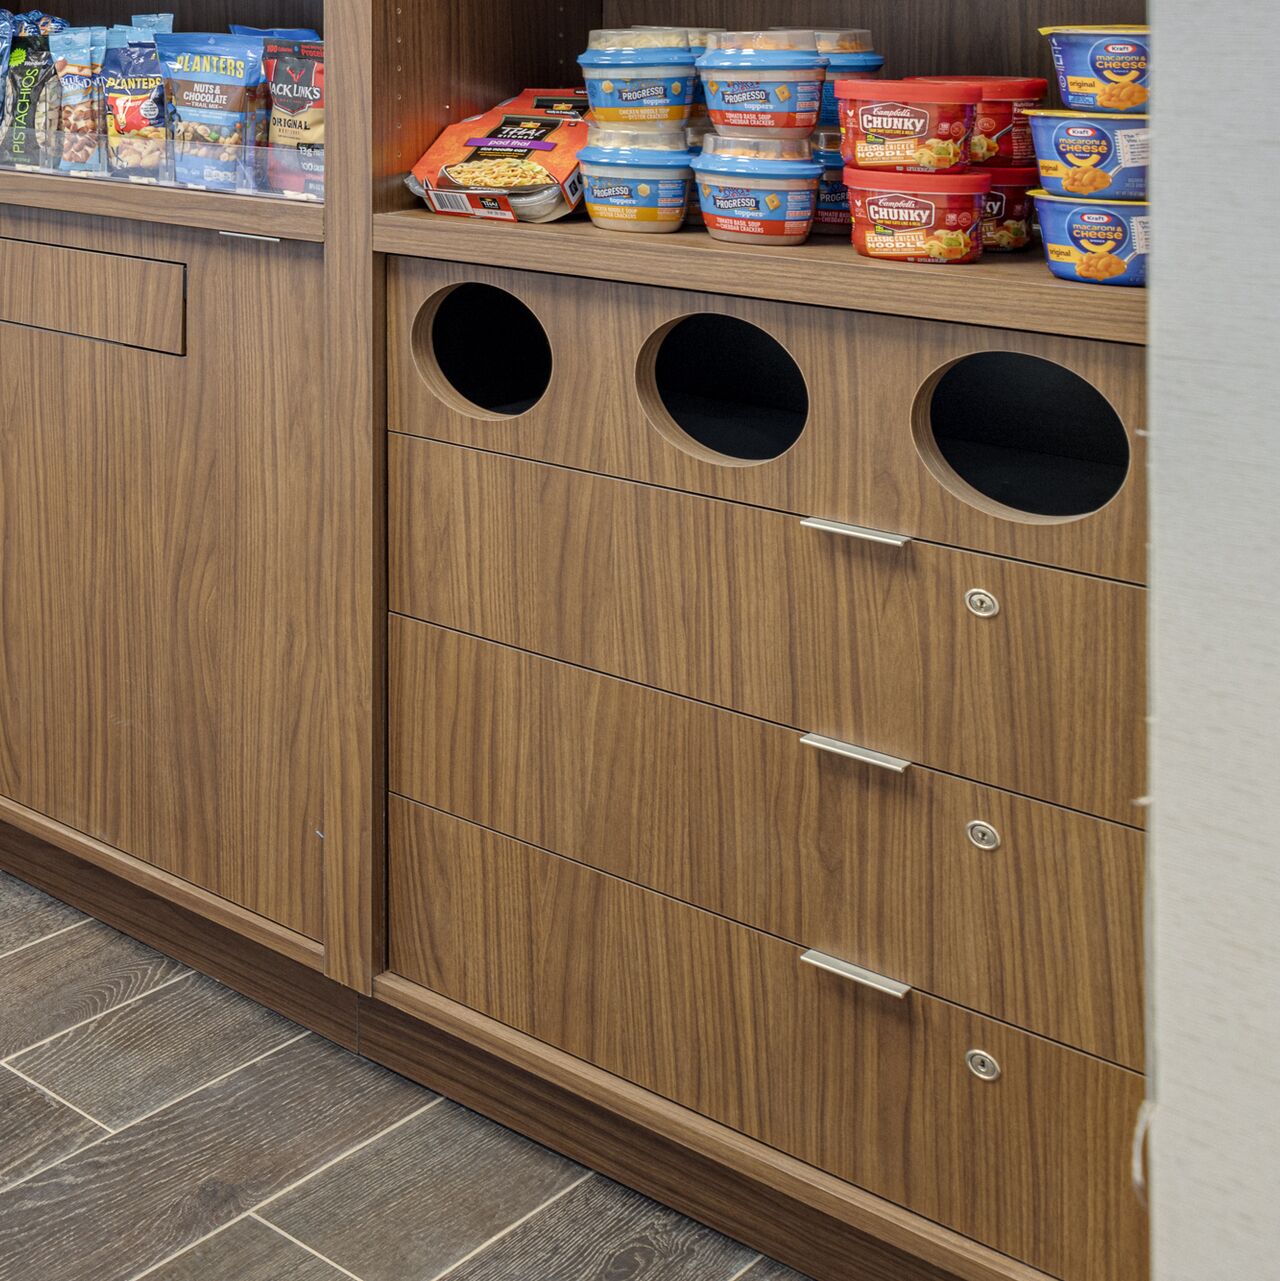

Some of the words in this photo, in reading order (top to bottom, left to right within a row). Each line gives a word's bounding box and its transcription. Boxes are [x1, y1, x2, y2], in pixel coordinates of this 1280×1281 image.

[1108, 44, 1129, 53] Kraft
[1096, 54, 1139, 63] macaroni
[174, 55, 245, 79] PLANTERS
[106, 77, 162, 89] PLANTERS
[193, 83, 213, 93] NUTS
[1068, 80, 1096, 90] original
[293, 84, 321, 100] LINK'S
[622, 85, 664, 101] PROGRESSO
[724, 90, 766, 104] PROGRESSO
[184, 91, 228, 105] CHOCOLATE
[643, 97, 669, 106] toppers
[13, 68, 39, 153] PISTACHIOS
[744, 102, 774, 111] toppers
[872, 106, 911, 117] Campbell's
[272, 116, 311, 130] ORIGINAL
[862, 115, 925, 132] CHUNKY
[501, 126, 547, 137] THAI
[1070, 128, 1091, 136] Kraft
[856, 143, 885, 153] CLASSIC
[885, 141, 915, 151] CHICKEN
[1059, 137, 1099, 147] macaroni
[856, 150, 914, 158] NOODLE
[593, 187, 629, 197] PROGRESSO
[610, 197, 636, 205] toppers
[716, 198, 755, 209] PROGRESSO
[877, 197, 916, 208] Campbell's
[734, 209, 764, 217] toppers
[868, 206, 931, 222] CHUNKY
[1084, 214, 1105, 222] Kraft
[1073, 223, 1114, 233] macaroni
[866, 234, 894, 243] CLASSIC
[894, 233, 925, 241] CHICKEN
